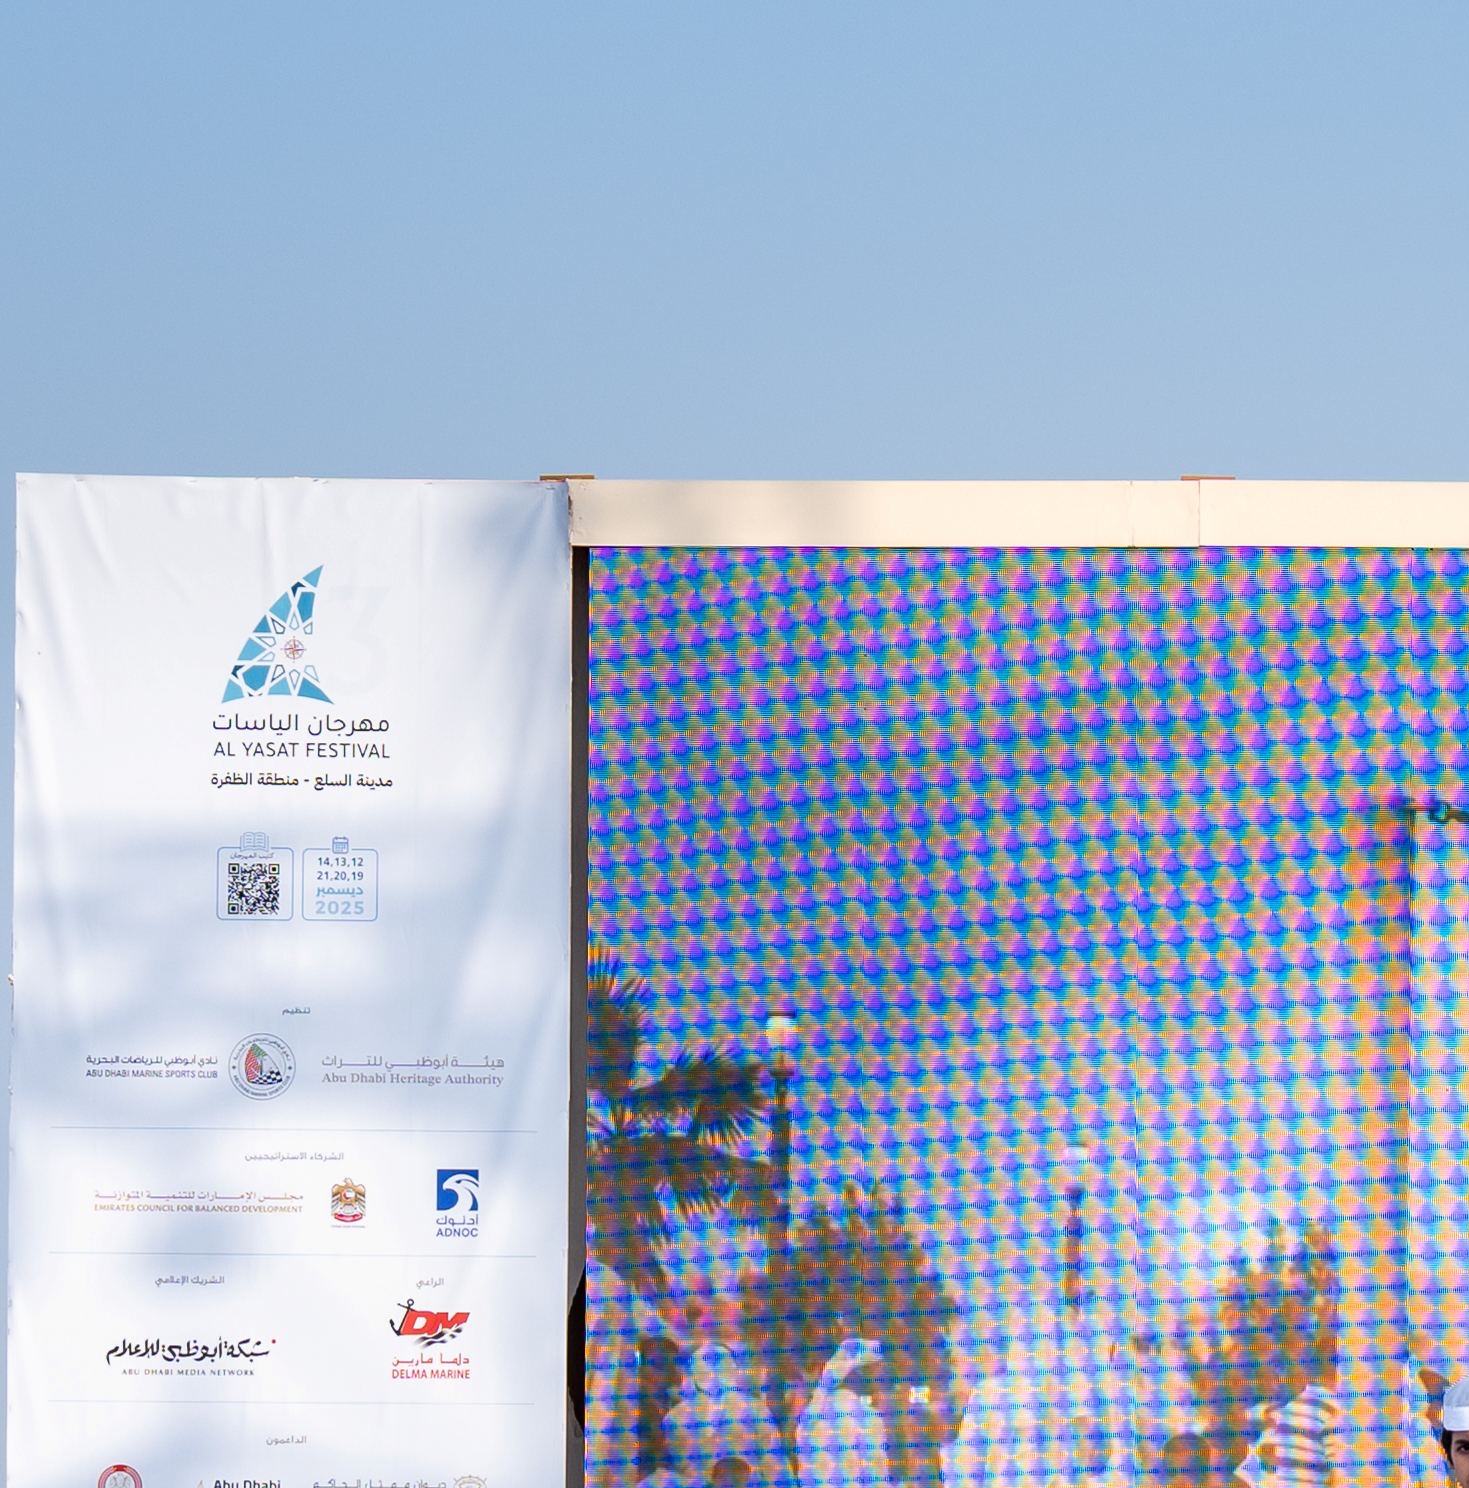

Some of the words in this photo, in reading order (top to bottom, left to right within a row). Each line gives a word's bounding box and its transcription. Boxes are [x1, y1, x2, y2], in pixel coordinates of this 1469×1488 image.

[212, 714, 299, 736] الياسات
[307, 714, 390, 736] مهرجان
[213, 742, 236, 757] AL
[242, 742, 300, 757] YASAT
[306, 743, 391, 759] FESTIVAL
[210, 772, 253, 788] الظفرة
[257, 773, 299, 786] منطقة
[313, 773, 352, 790] السلع
[356, 775, 394, 789] مدينة
[316, 886, 364, 898] ديسمبر
[315, 901, 365, 915] 2025
[86, 1070, 104, 1078] ABU
[104, 1070, 130, 1078] DHABI
[131, 1070, 163, 1078] MARINE
[164, 1070, 196, 1078] SPORTS
[197, 1070, 219, 1079] CLUB
[321, 1072, 347, 1083] Abu
[351, 1072, 387, 1084] Dhabi
[390, 1073, 442, 1087] Heritage
[444, 1074, 504, 1087] Authority
[94, 1204, 136, 1212] EMIRATES
[136, 1204, 175, 1213] COUNCIL
[176, 1204, 194, 1213] FOR
[194, 1205, 240, 1213] BALANCED
[241, 1205, 303, 1214] DEVELOPMENT
[436, 1214, 479, 1226] أدنوك
[435, 1228, 479, 1238] ADNOC
[391, 1369, 428, 1379] DELMA
[430, 1369, 471, 1379] MARINE
